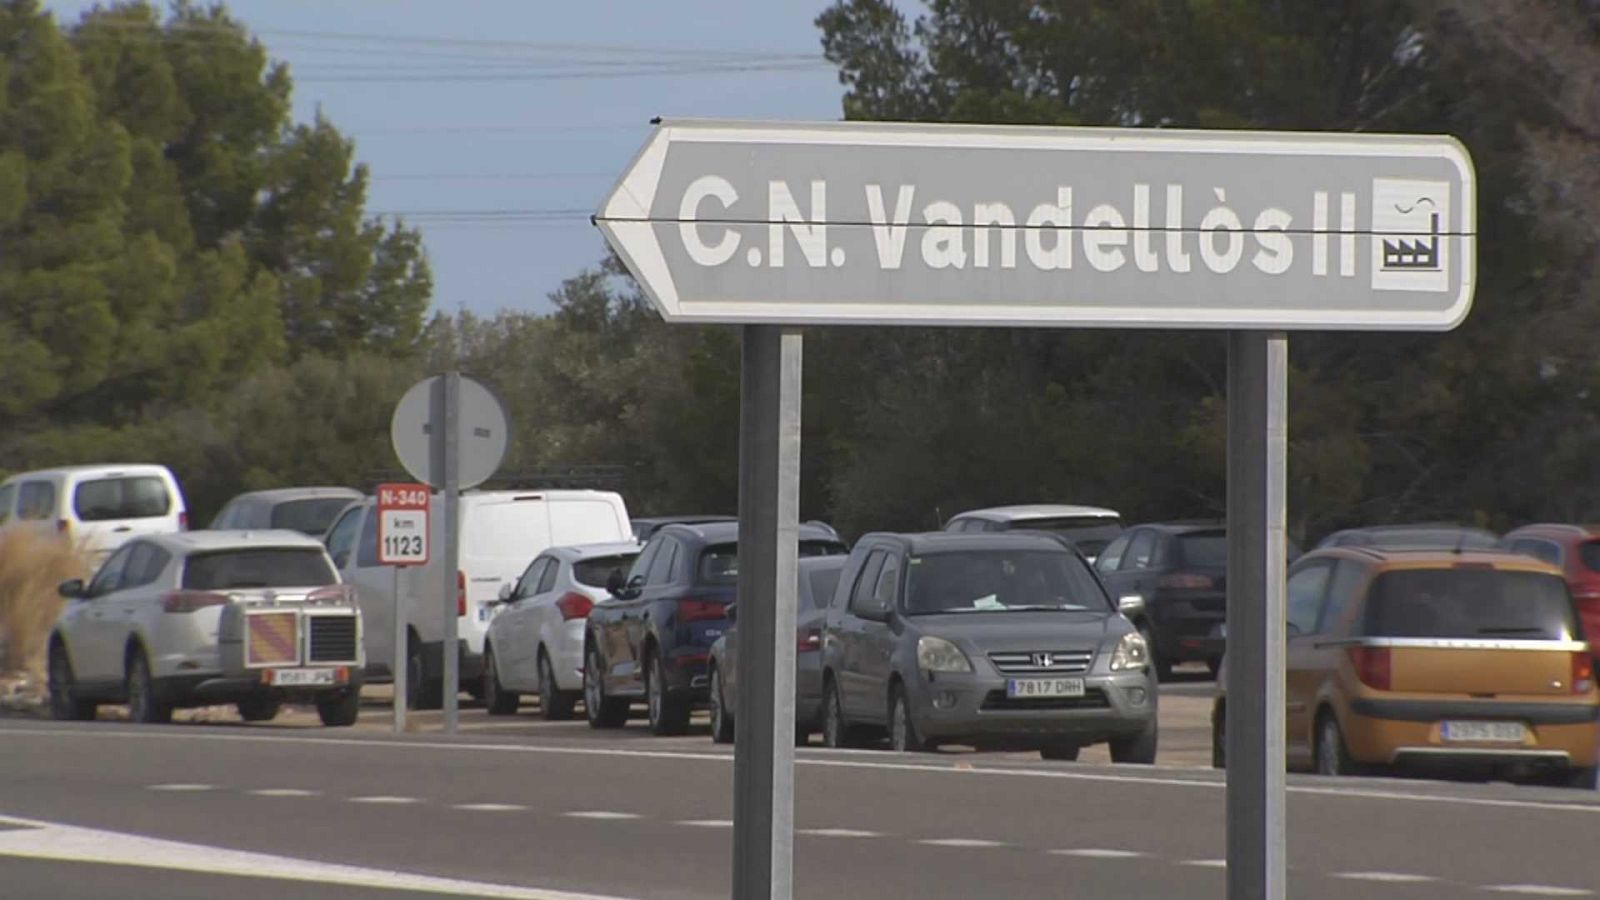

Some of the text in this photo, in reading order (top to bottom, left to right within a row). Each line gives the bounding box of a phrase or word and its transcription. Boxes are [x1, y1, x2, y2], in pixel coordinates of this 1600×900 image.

[678, 175, 846, 267] C.N.
[865, 184, 1295, 275] Vandellòs
[381, 489, 426, 505] N-340
[393, 517, 415, 528] km
[385, 535, 422, 556] 1123
[1018, 681, 1052, 695] 7817
